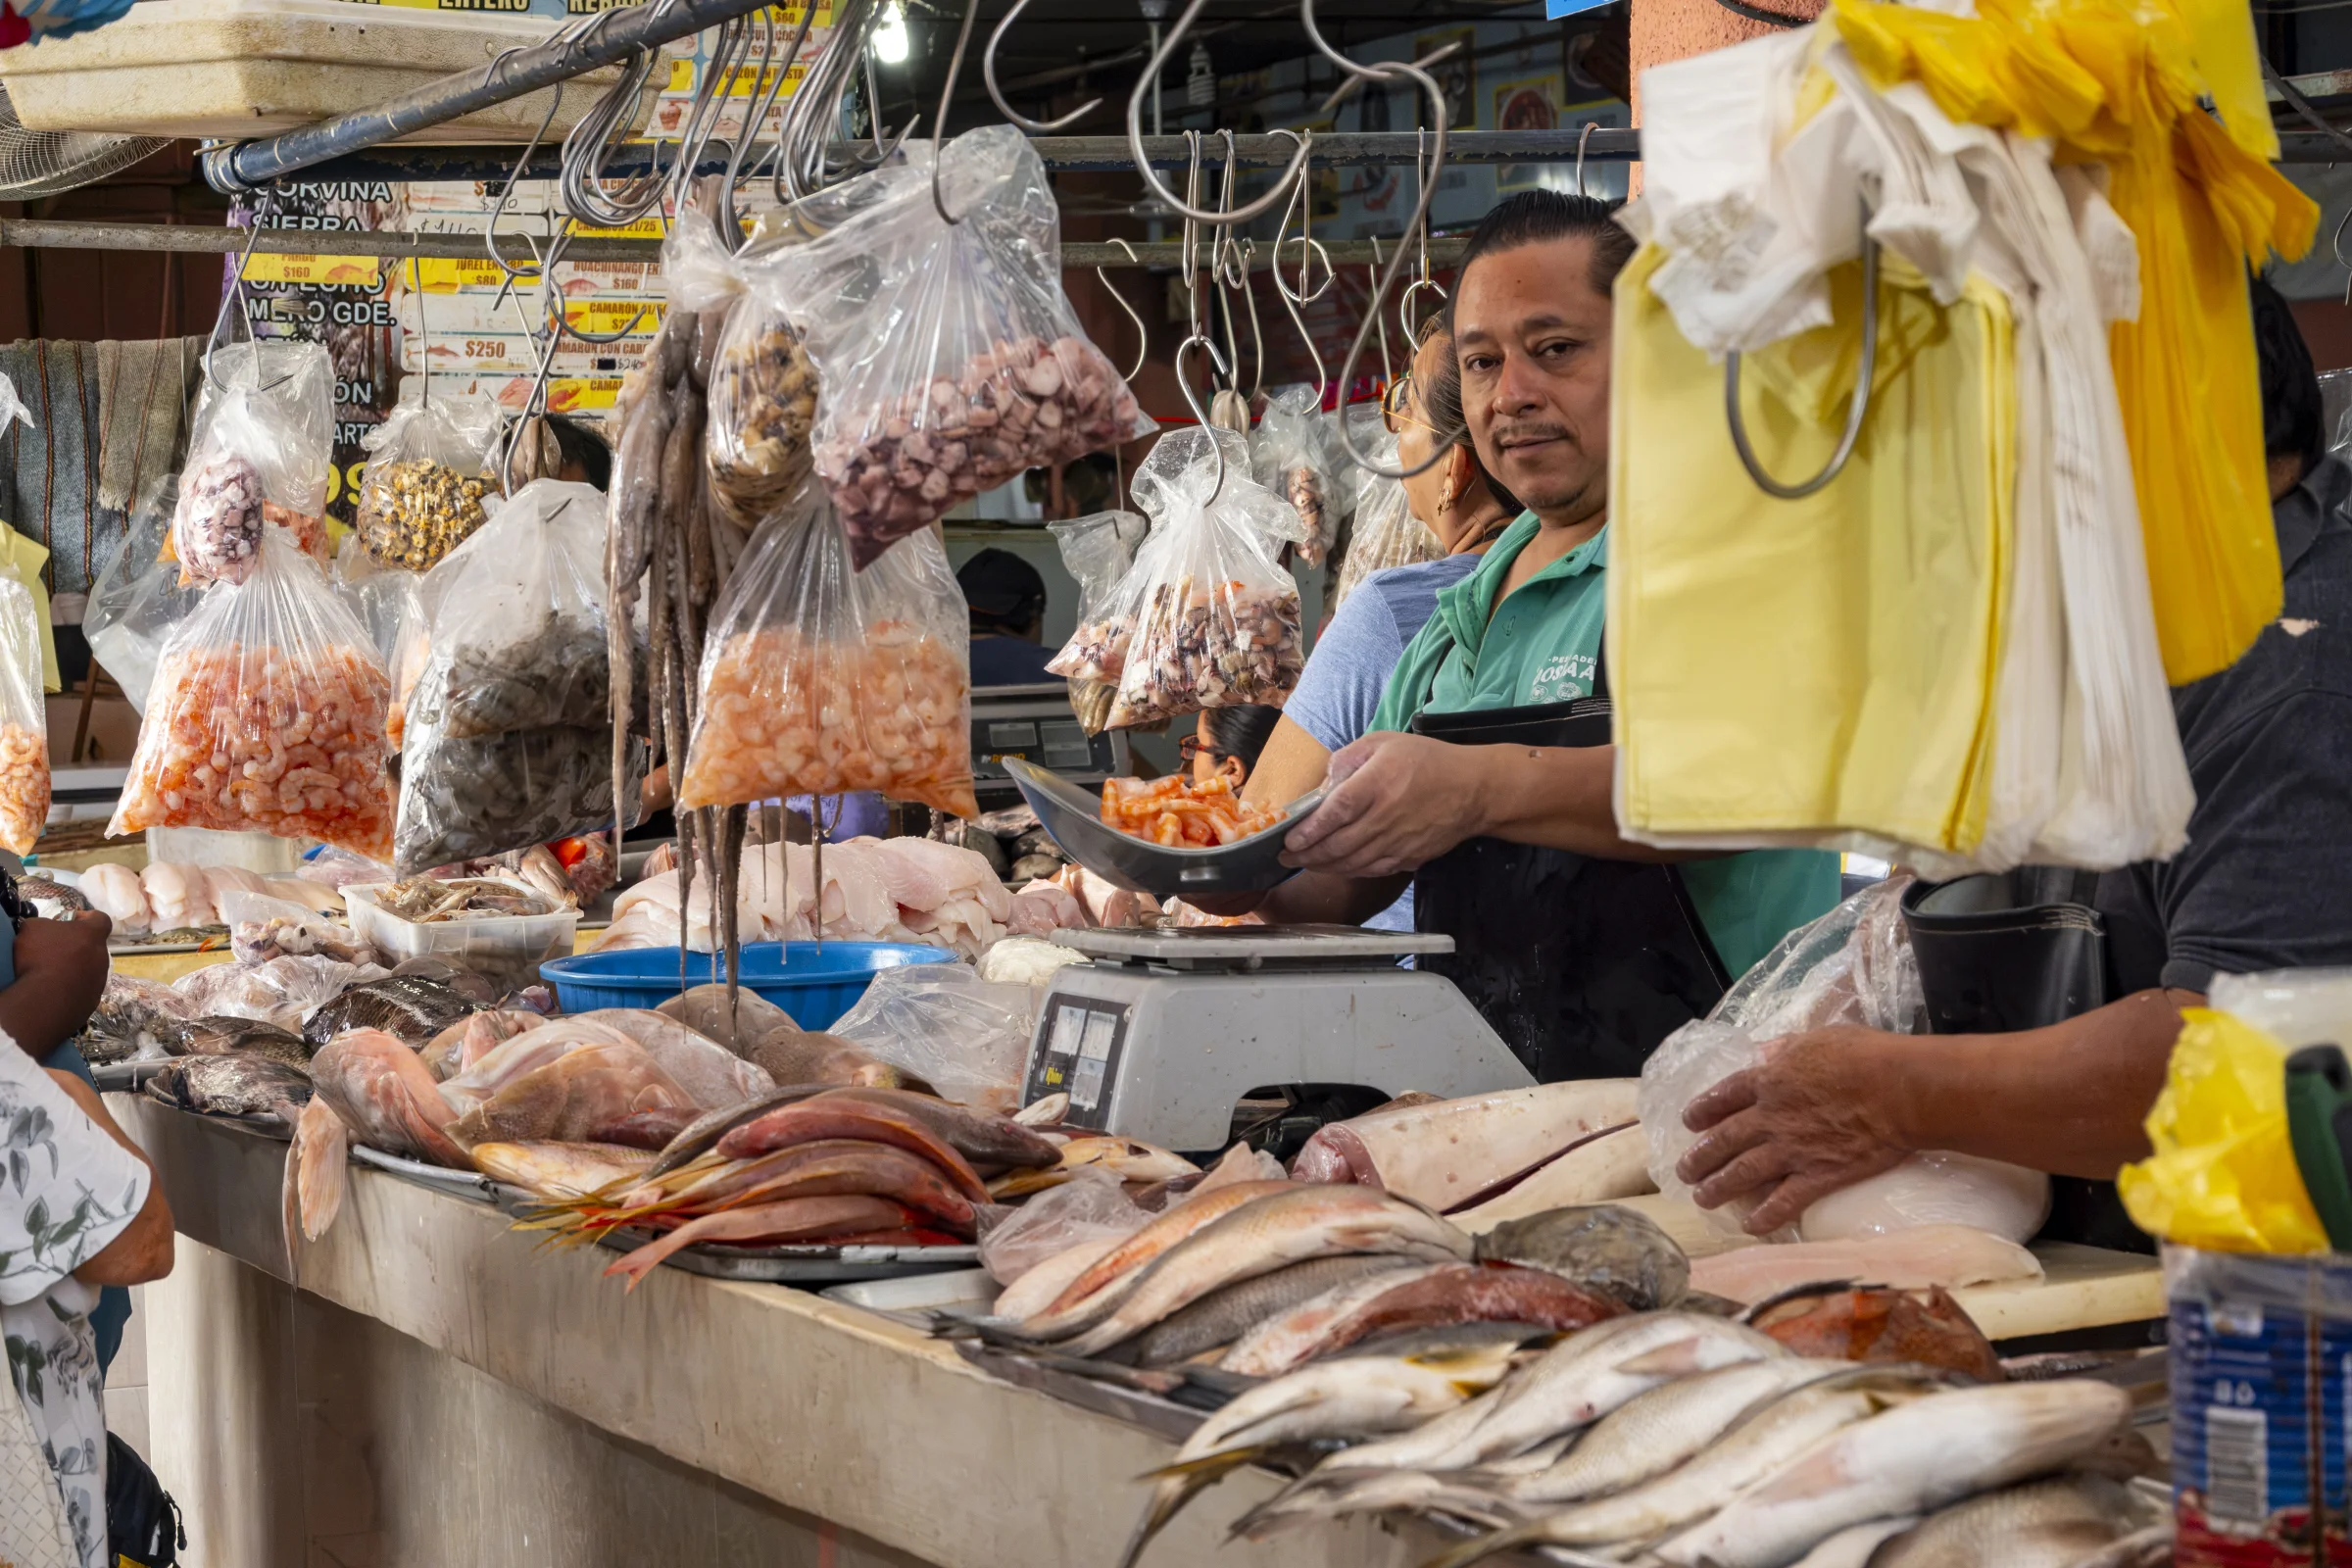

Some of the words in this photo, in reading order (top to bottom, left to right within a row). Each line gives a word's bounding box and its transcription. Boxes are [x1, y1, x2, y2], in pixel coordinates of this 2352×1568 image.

[627, 220, 657, 232] 21/25
[456, 260, 483, 270] JUREL
[573, 262, 644, 274] HUACHINANGO
[283, 266, 311, 278] $160
[476, 274, 497, 286] $80
[612, 278, 638, 290] $160
[333, 301, 397, 326] GDE.
[466, 340, 506, 359] $250
